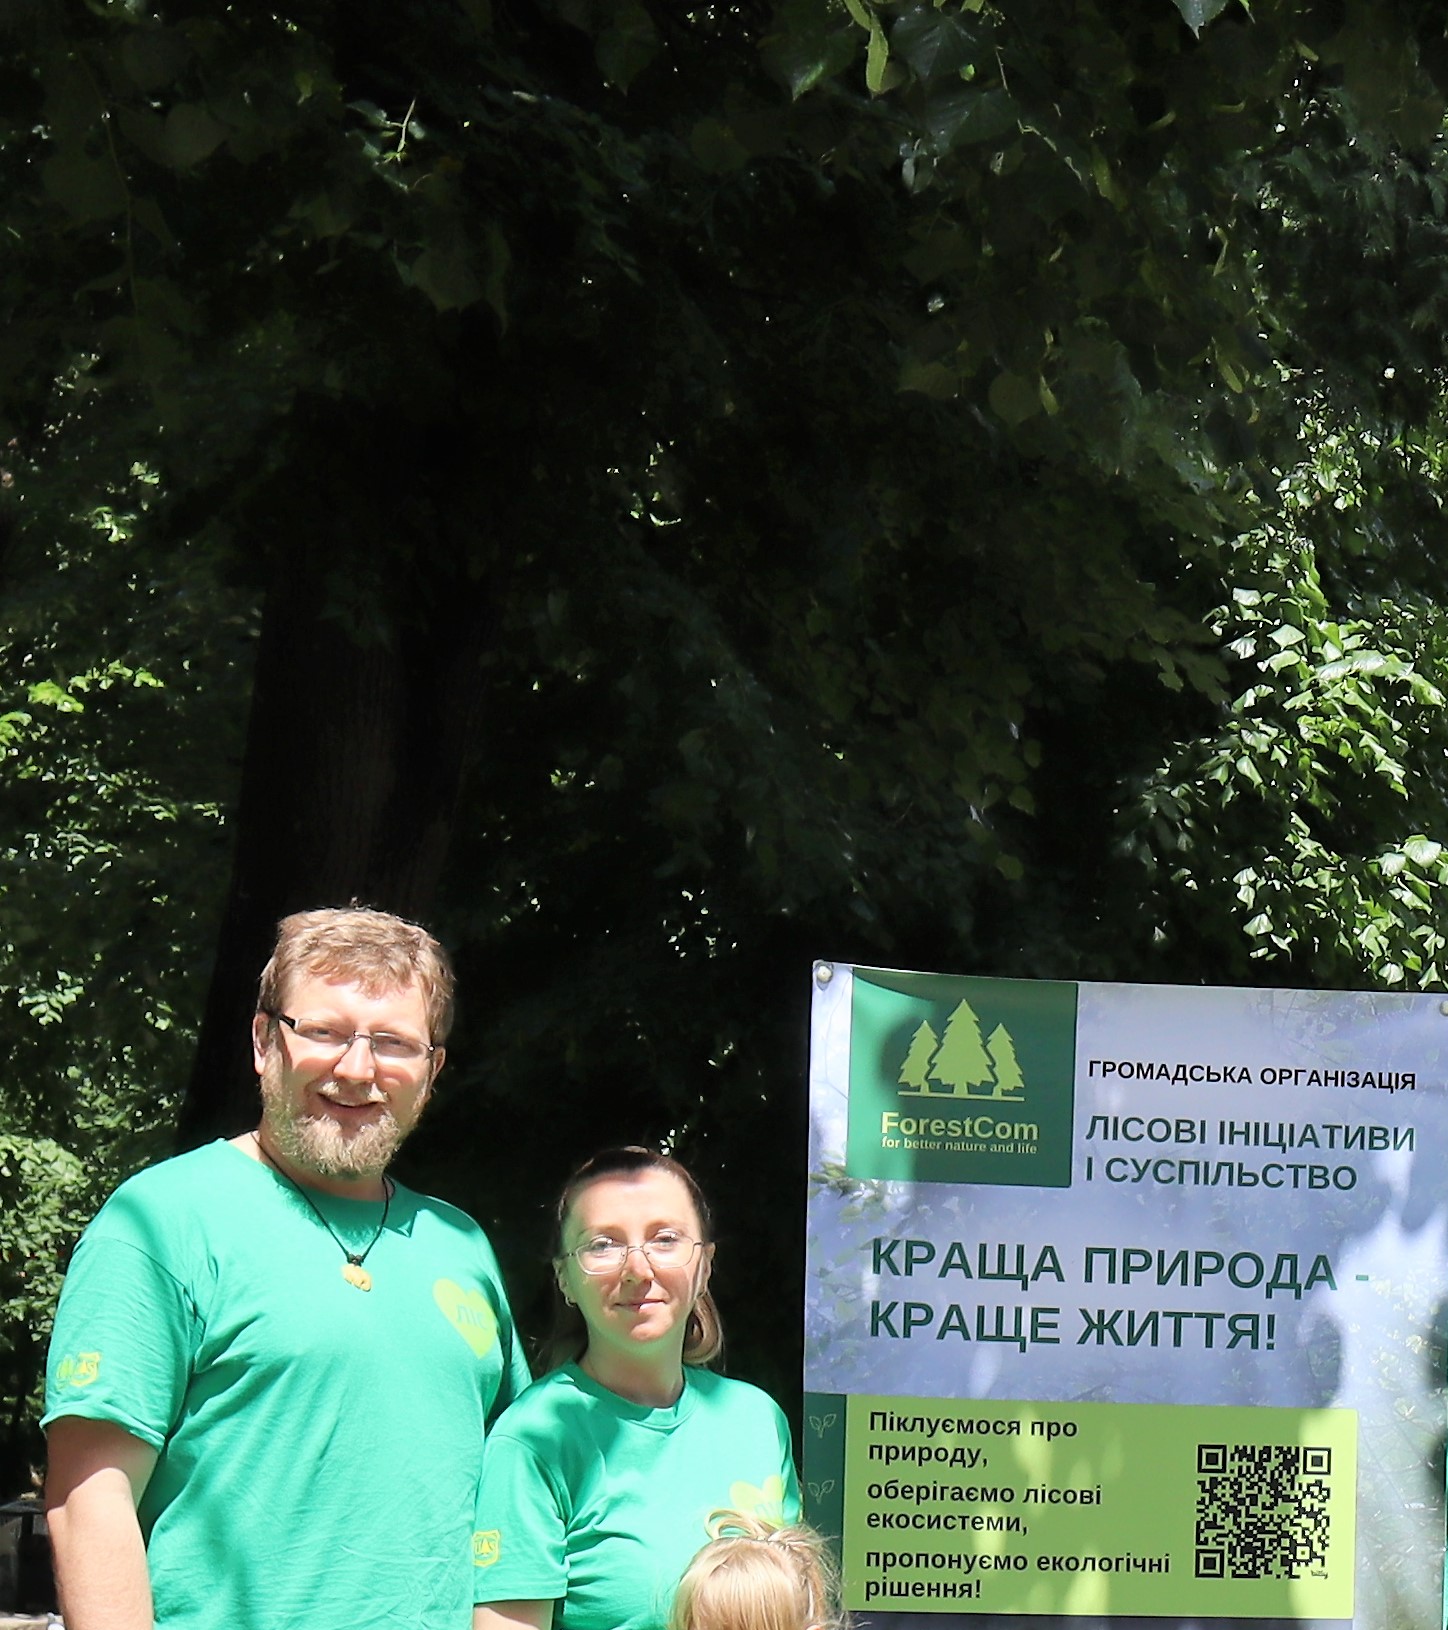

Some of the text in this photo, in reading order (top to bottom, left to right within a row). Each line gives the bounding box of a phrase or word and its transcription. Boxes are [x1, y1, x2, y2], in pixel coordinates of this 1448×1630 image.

[1088, 1060, 1416, 1094] ГРОМАДСЬКА ОРГАНІЗАЦІЯ
[881, 1111, 1039, 1141] ForestCom
[1085, 1115, 1415, 1154] ЛІСОВІ ІНІЦІАТИВИ
[881, 1136, 1037, 1154] for better nature and life
[1105, 1157, 1357, 1190] СУСПІЛЬСТВО
[871, 1238, 1065, 1292] КРАЩА
[1083, 1246, 1339, 1301] ПРИРОДА
[869, 1300, 1277, 1353] КРАЩЕ ЖИТТЯ!
[869, 1411, 1078, 1441] Піклуємося про
[868, 1444, 988, 1468] природу,
[867, 1480, 1102, 1505] оберігаємо лісові
[866, 1512, 1028, 1536] екосистеми,
[865, 1551, 1170, 1574] пропонуємо екологічні
[865, 1577, 981, 1600] рішення!
